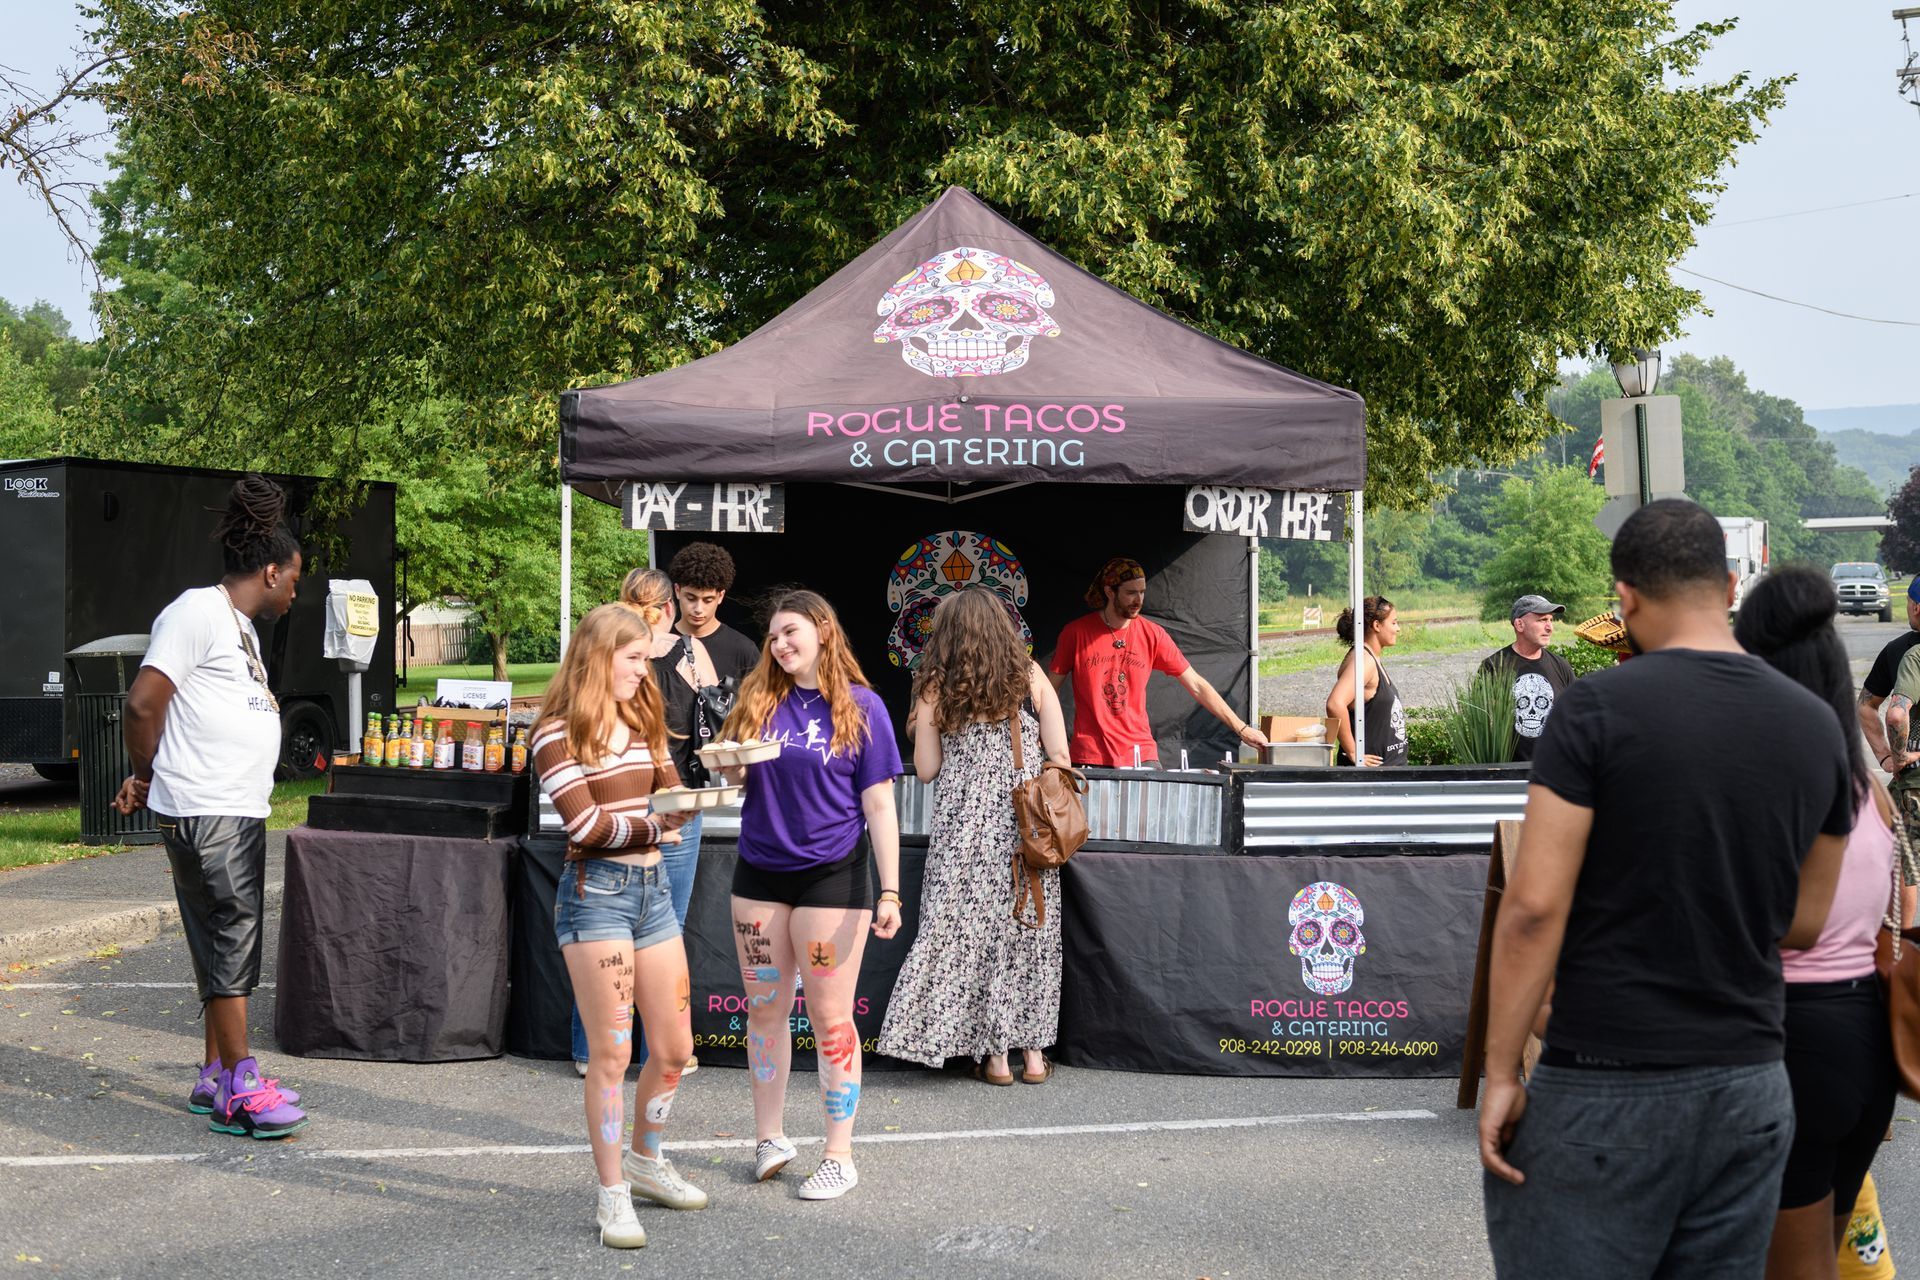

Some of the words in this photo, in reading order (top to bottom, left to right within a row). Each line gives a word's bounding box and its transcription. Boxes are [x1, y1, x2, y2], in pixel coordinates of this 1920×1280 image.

[807, 403, 962, 437] ROGUE
[974, 404, 1126, 433] TACOS
[849, 441, 873, 468] &
[883, 438, 1084, 467] CATERING
[4, 477, 48, 490] LOOK
[632, 482, 688, 530] PAY
[711, 482, 774, 532] HERE
[1186, 485, 1272, 537] ORDER
[1280, 489, 1333, 541] HERE
[357, 595, 376, 605] PARKING
[1250, 1000, 1328, 1018] ROGUE
[1334, 1001, 1409, 1018] TACOS
[1272, 1021, 1284, 1035] &
[1288, 1021, 1388, 1036] CATERING
[1219, 1039, 1322, 1056] 908-242-0298
[1339, 1041, 1438, 1056] 908-246-6090
